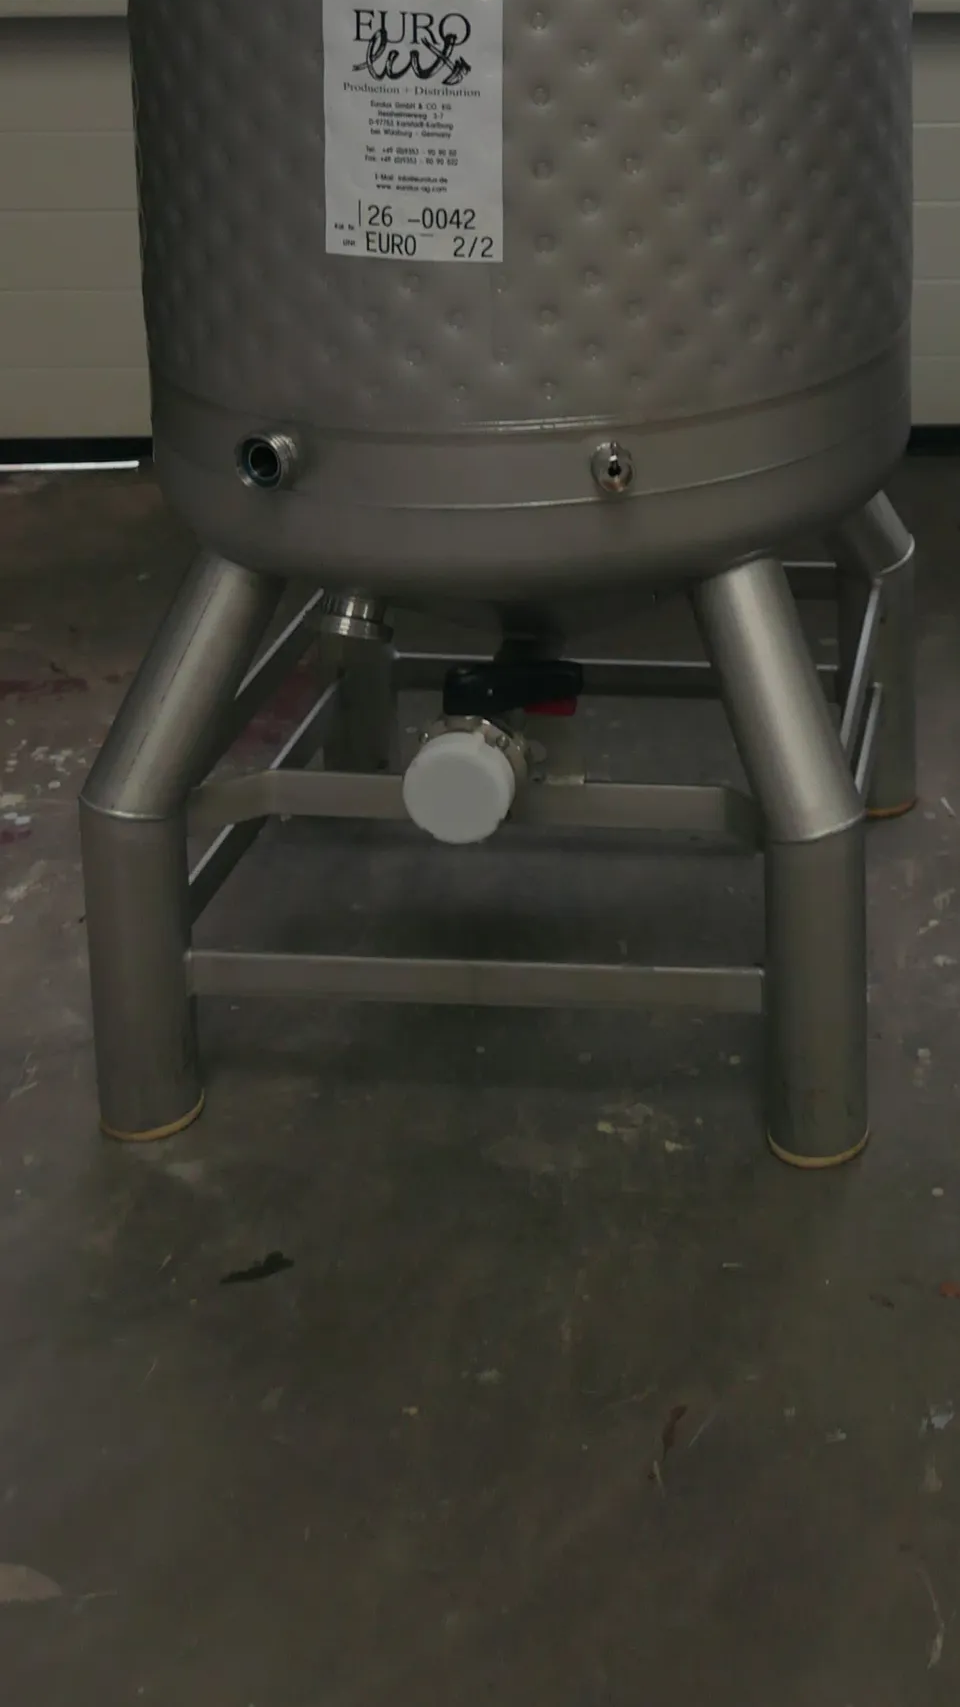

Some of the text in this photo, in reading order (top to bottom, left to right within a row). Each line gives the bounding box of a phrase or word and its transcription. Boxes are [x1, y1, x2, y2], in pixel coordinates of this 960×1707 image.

[352, 9, 471, 45] EURO
[343, 81, 400, 95] Production
[414, 85, 481, 98] Distribution
[367, 204, 476, 230] 26 -0042
[365, 230, 494, 258] EURO 2/2
